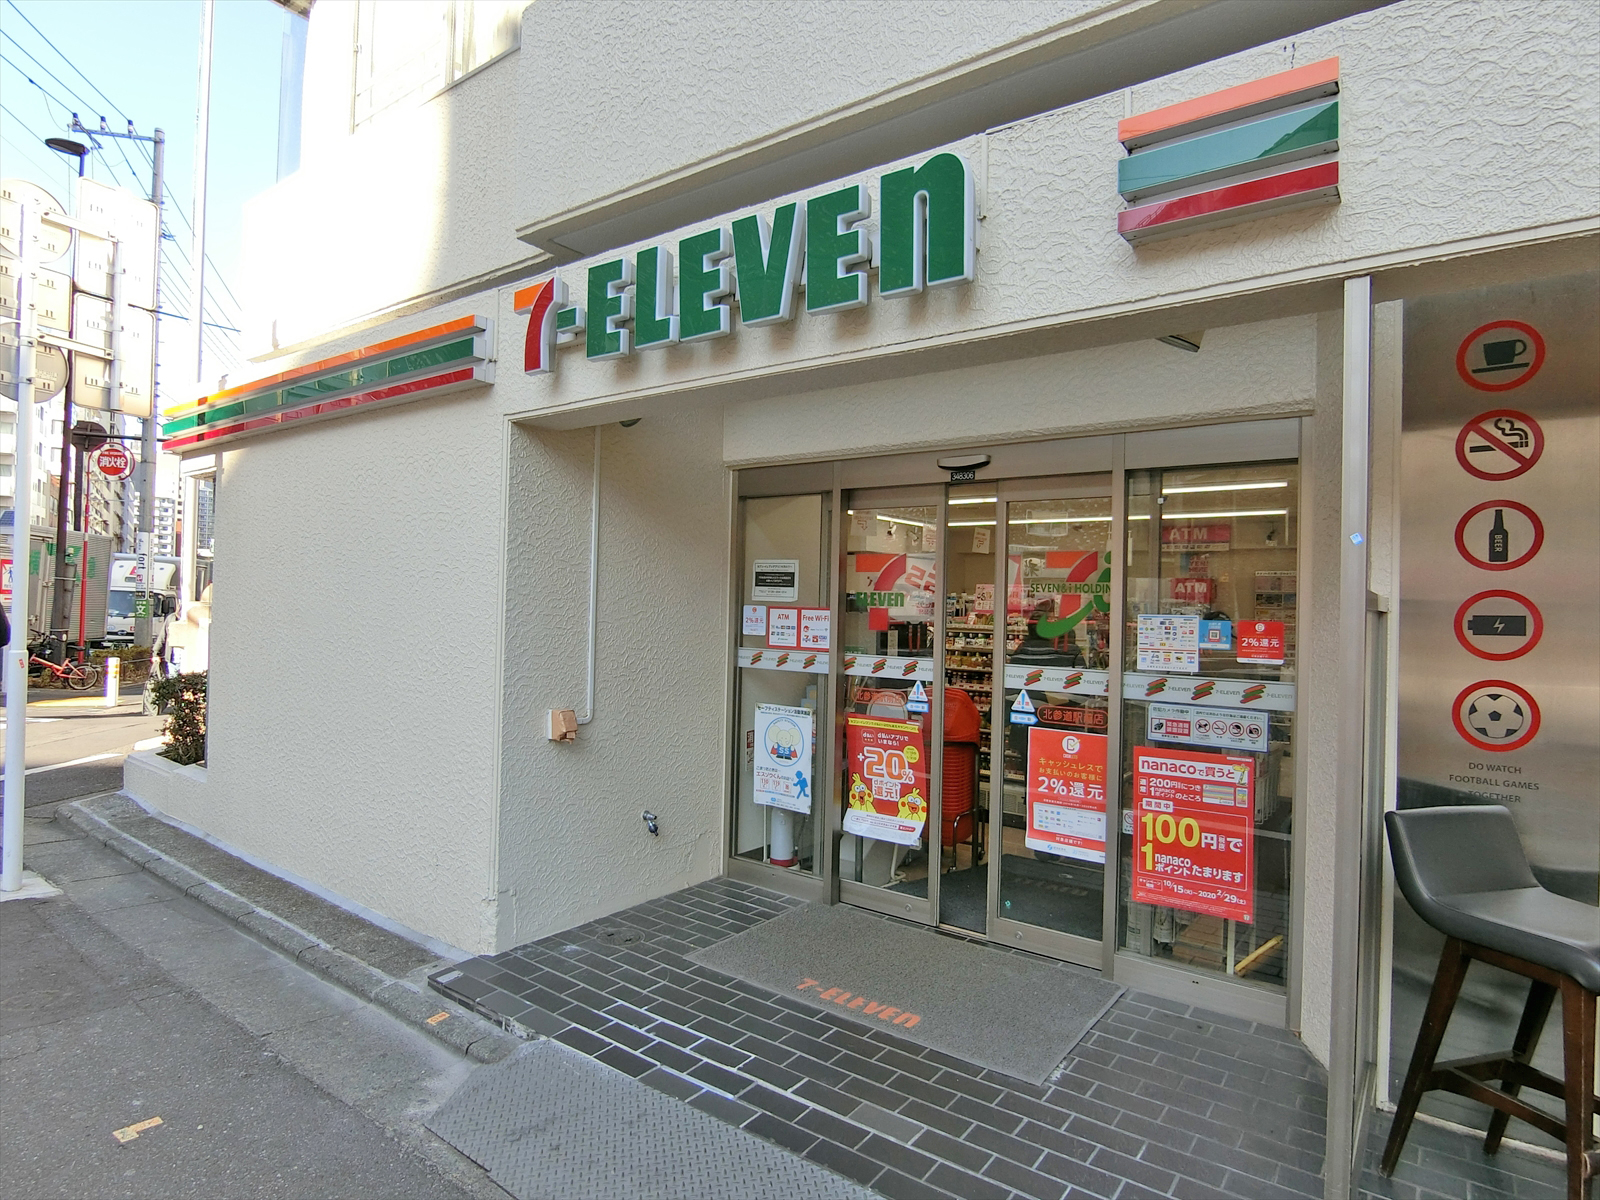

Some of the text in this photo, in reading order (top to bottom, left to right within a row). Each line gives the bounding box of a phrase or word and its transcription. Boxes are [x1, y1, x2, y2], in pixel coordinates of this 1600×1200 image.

[99, 456, 127, 468] 消火栓
[1169, 527, 1208, 541] ATM
[1494, 534, 1503, 552] BEER
[138, 553, 147, 570] fort
[1175, 582, 1207, 594] ATM
[777, 613, 790, 621] ATM
[1241, 637, 1279, 648] 2%還元
[1043, 708, 1104, 725] 北参道駅前店
[877, 732, 909, 741] d払いアプリで
[1039, 757, 1104, 773] キャッシュレスで
[1468, 762, 1522, 774] DO WATCH
[1039, 767, 1103, 781] お支払いのお客様に
[1037, 776, 1104, 800] 2%還元
[1449, 774, 1540, 791] FOOTBALL GAMES
[1468, 790, 1521, 803] TOGETHER
[1145, 800, 1170, 809] 期間中
[1154, 853, 1191, 867] nanaco
[1154, 863, 1244, 883] ポイント たまります
